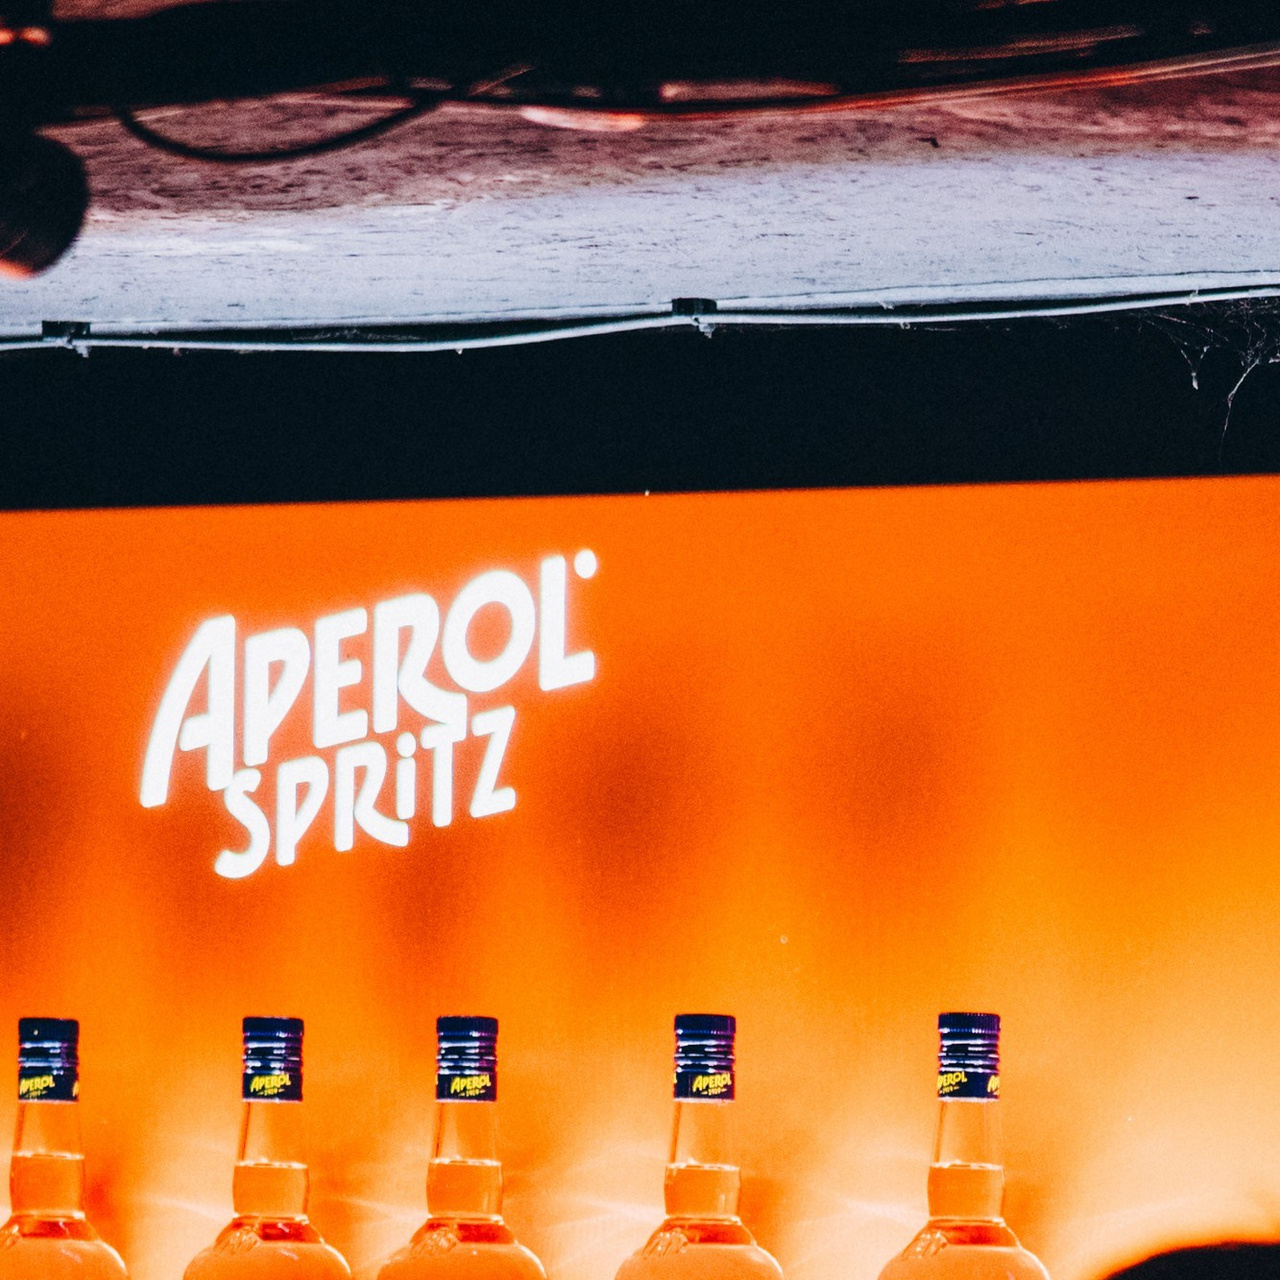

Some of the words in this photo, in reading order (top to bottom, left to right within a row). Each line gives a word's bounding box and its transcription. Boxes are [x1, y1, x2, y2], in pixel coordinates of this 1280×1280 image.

[140, 552, 597, 808] APEROL
[19, 1074, 55, 1095] APEROL
[250, 1073, 291, 1093] APEROL
[450, 1073, 491, 1094] APEROL
[692, 1072, 733, 1092] APEROL
[937, 1071, 967, 1089] PEROL
